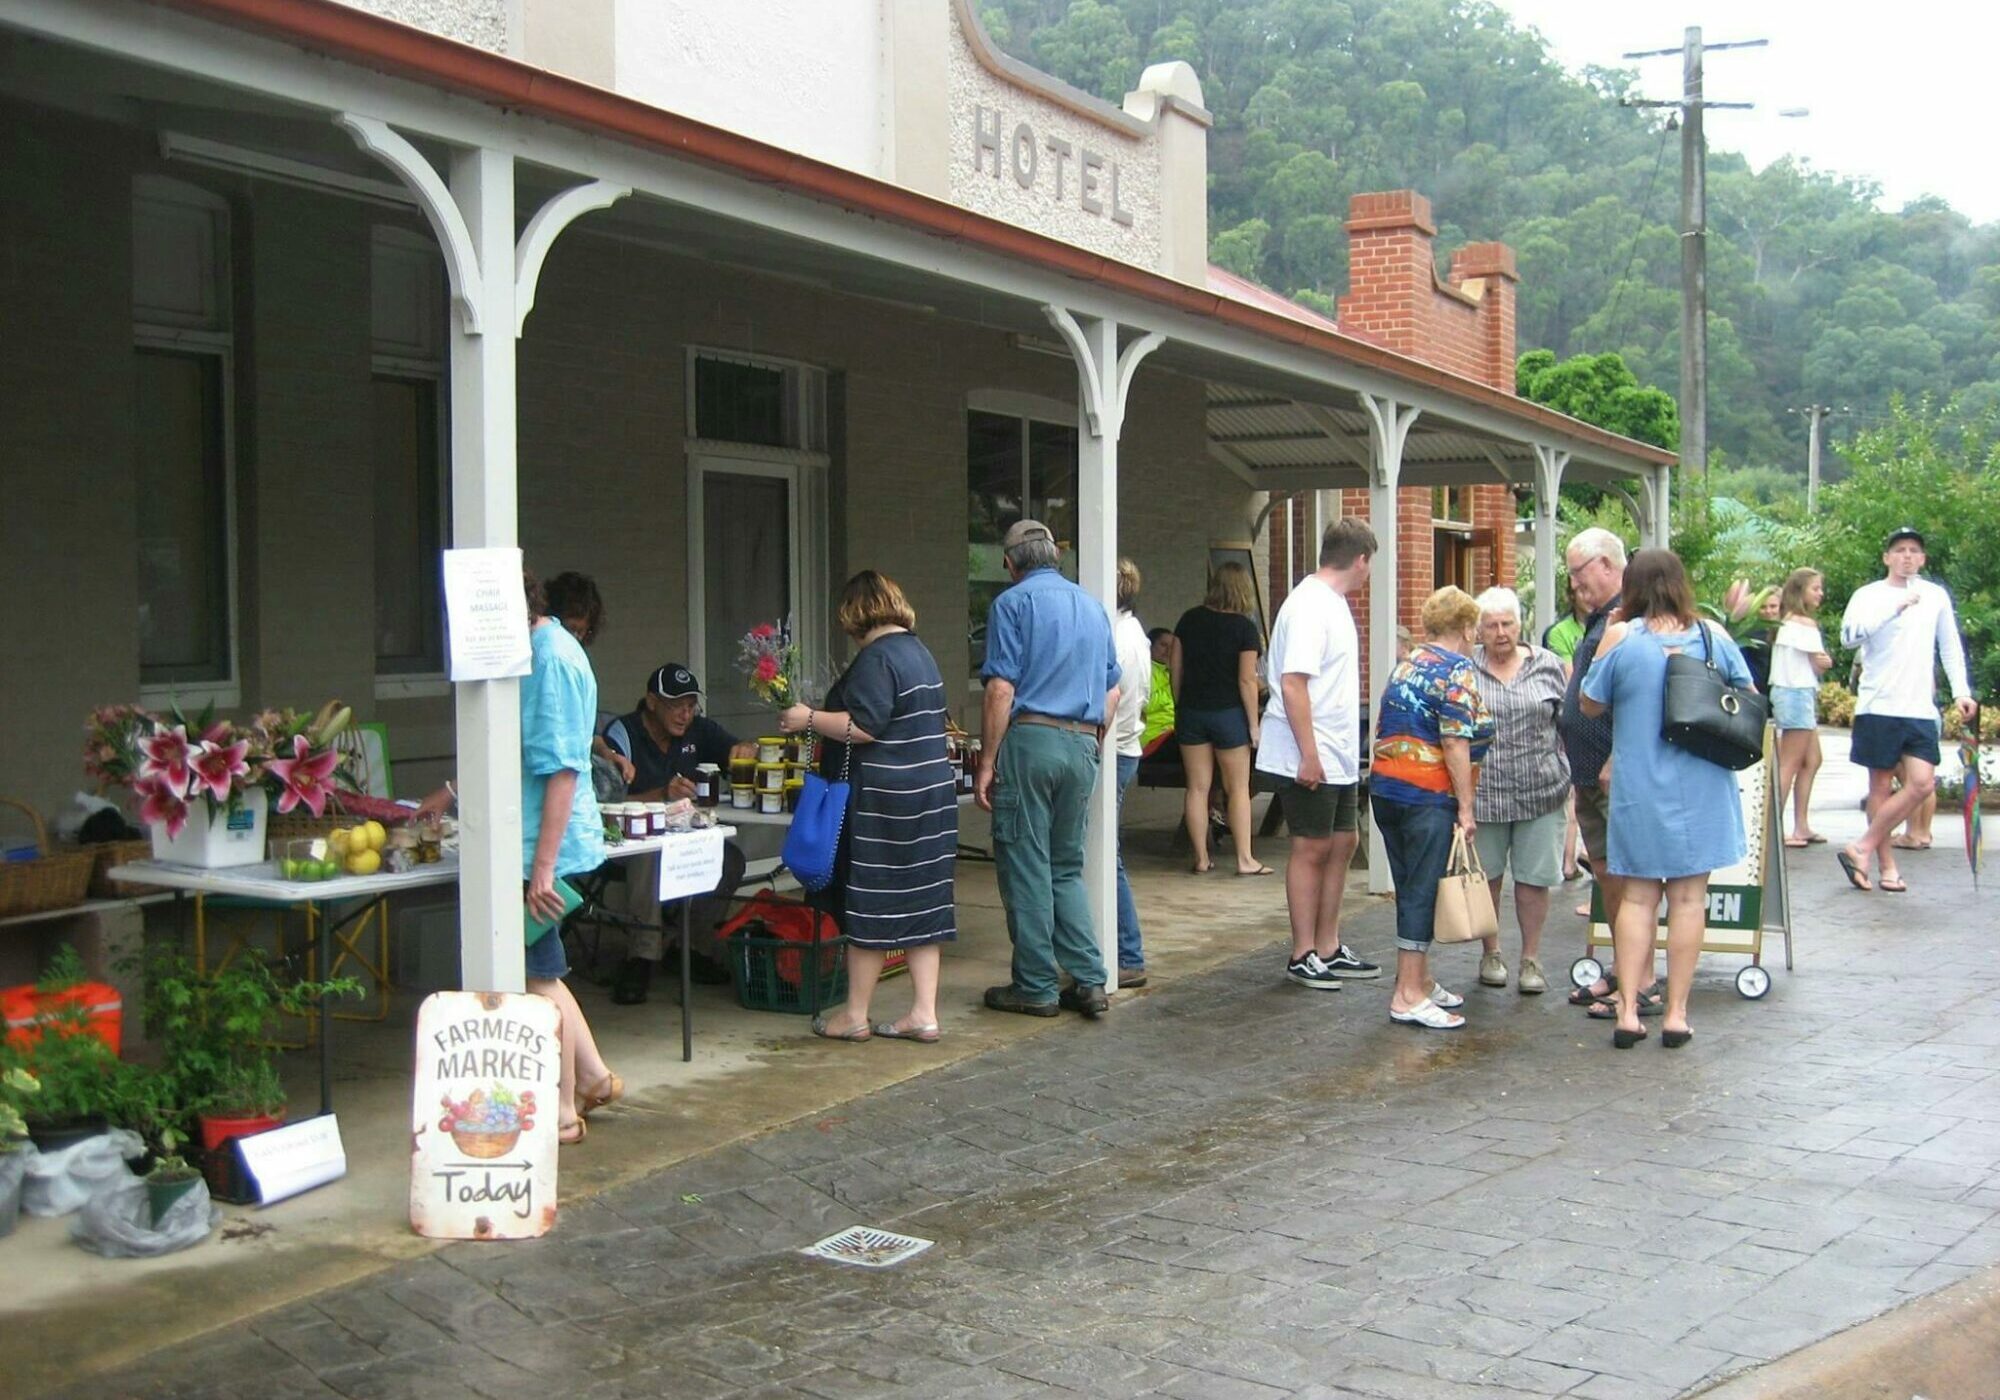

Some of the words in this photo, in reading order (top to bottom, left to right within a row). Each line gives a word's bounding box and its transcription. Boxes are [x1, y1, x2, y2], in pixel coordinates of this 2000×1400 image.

[974, 104, 1135, 228] HOTEL
[434, 1018, 548, 1055] FARMERS
[436, 1048, 547, 1083] MARKET
[432, 1171, 532, 1219] Today
